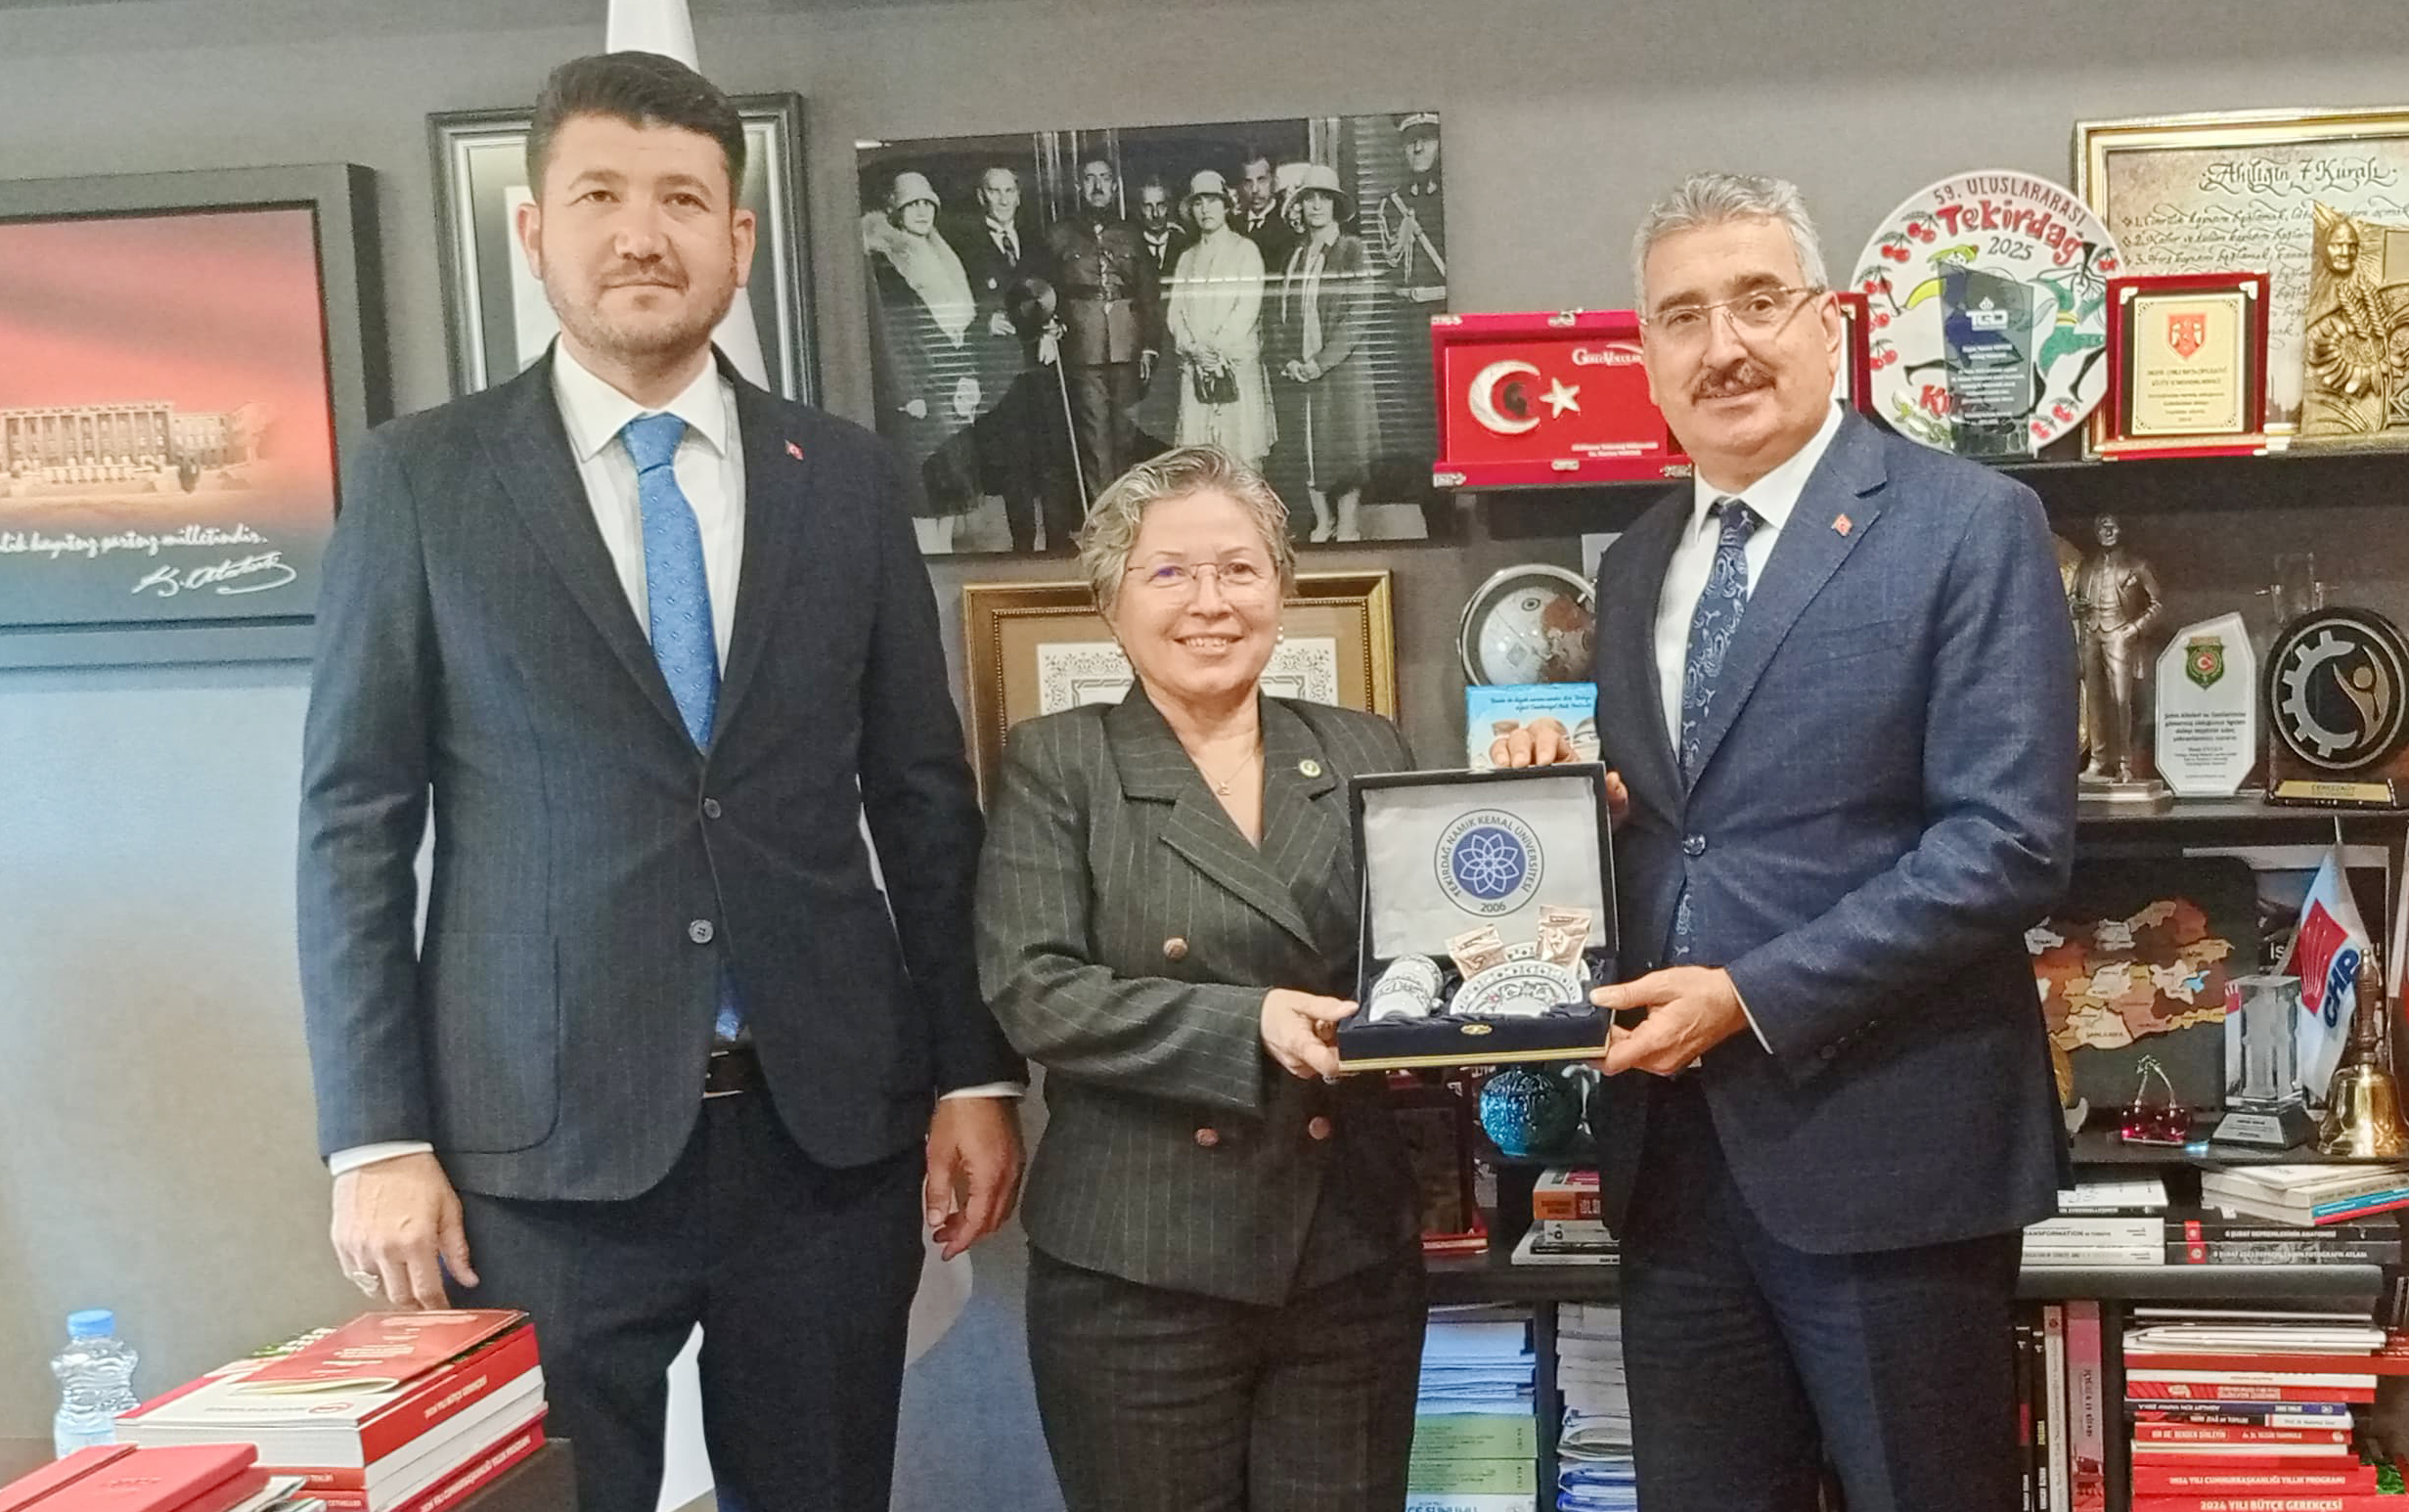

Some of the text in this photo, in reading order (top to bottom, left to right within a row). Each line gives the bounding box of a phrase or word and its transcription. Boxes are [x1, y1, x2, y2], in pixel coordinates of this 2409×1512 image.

[1934, 177, 2087, 226] 59. ULUSLARARASI
[1937, 200, 2083, 266] Tekirdağ
[1987, 236, 2034, 260] 2025
[1441, 815, 1538, 898] TEKİRDAĞ NAMIK KEMAL ÜNİVERSİTESİ
[1480, 901, 1506, 912] 2006
[2324, 948, 2359, 1028] CHP
[2228, 1499, 2250, 1511] YILI
[2250, 1497, 2284, 1512] BÜTÇE
[2286, 1497, 2343, 1512] GEREKÇESİ
